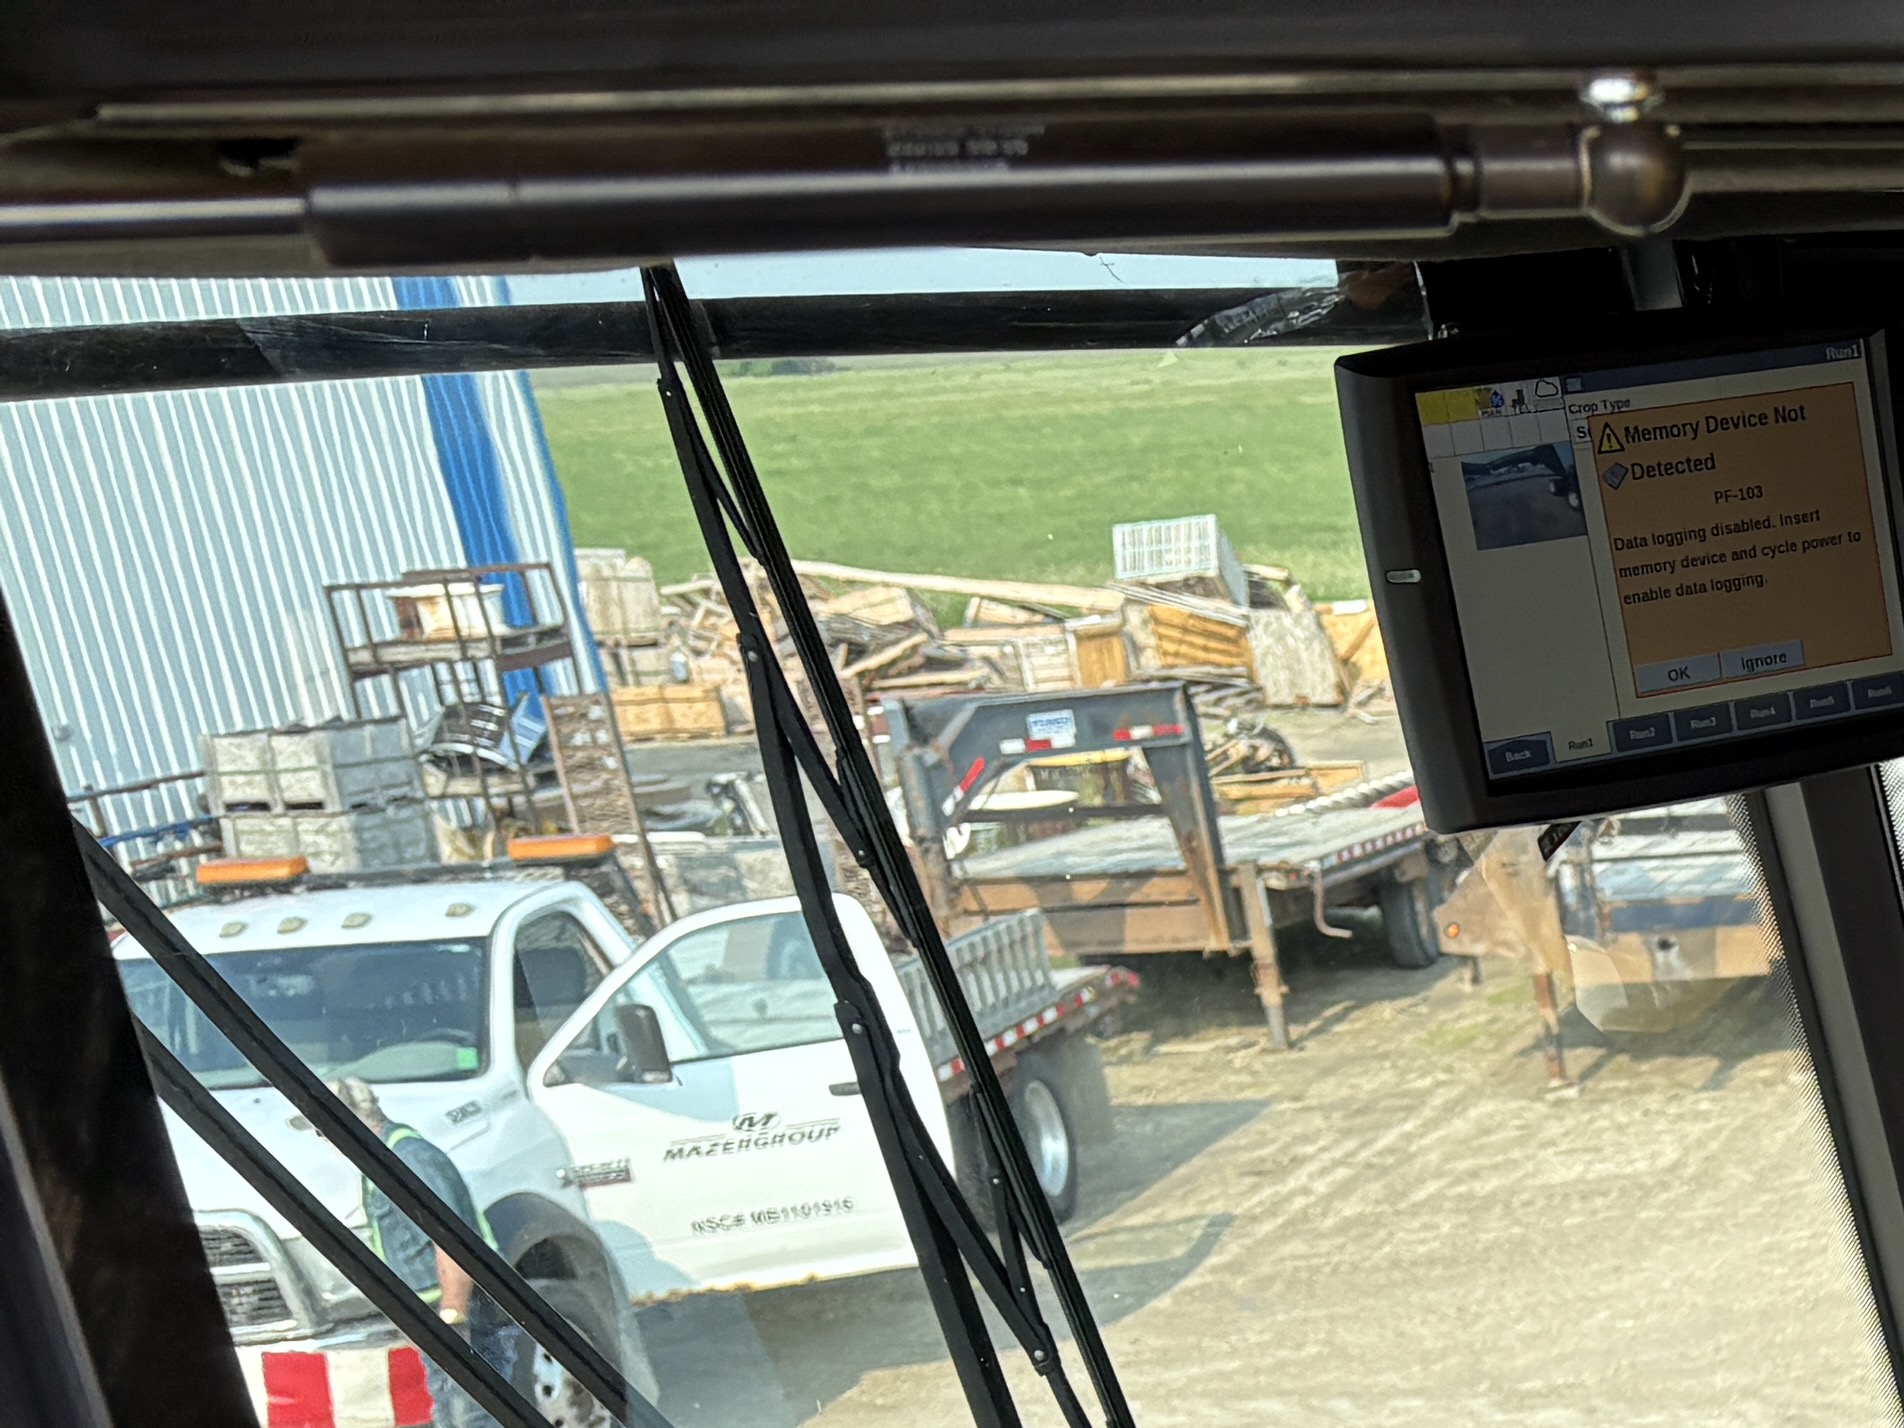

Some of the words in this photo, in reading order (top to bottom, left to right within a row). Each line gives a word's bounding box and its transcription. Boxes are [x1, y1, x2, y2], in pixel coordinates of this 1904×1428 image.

[1825, 344, 1860, 360] Run1
[1568, 402, 1599, 416] Crop
[1602, 398, 1631, 413] Type
[1624, 420, 1700, 446] Memory
[1705, 409, 1768, 435] Device
[1774, 404, 1806, 425] Not
[1631, 452, 1716, 481] Detected
[1714, 485, 1764, 504] PF-103
[1613, 535, 1648, 552] Data
[1652, 526, 1707, 548] logging
[1711, 515, 1776, 537] disabled.
[1780, 509, 1821, 527] Insert
[1619, 559, 1676, 579] memory
[1680, 549, 1727, 570] device
[1731, 544, 1757, 562] and
[1761, 537, 1797, 559] cycle
[1802, 532, 1843, 556] power
[1847, 529, 1861, 544] to
[1623, 584, 1671, 606] enable
[1676, 579, 1707, 598] data
[1710, 571, 1768, 595] logging.
[1741, 651, 1787, 674] Ignore
[1667, 666, 1691, 682] OK
[1750, 706, 1776, 719] Run4
[1690, 716, 1717, 730] Run3
[1629, 726, 1656, 740] Run2
[1568, 738, 1594, 752] Run1
[1505, 747, 1532, 763] Back
[662, 1125, 841, 1162] MAZERGROUP
